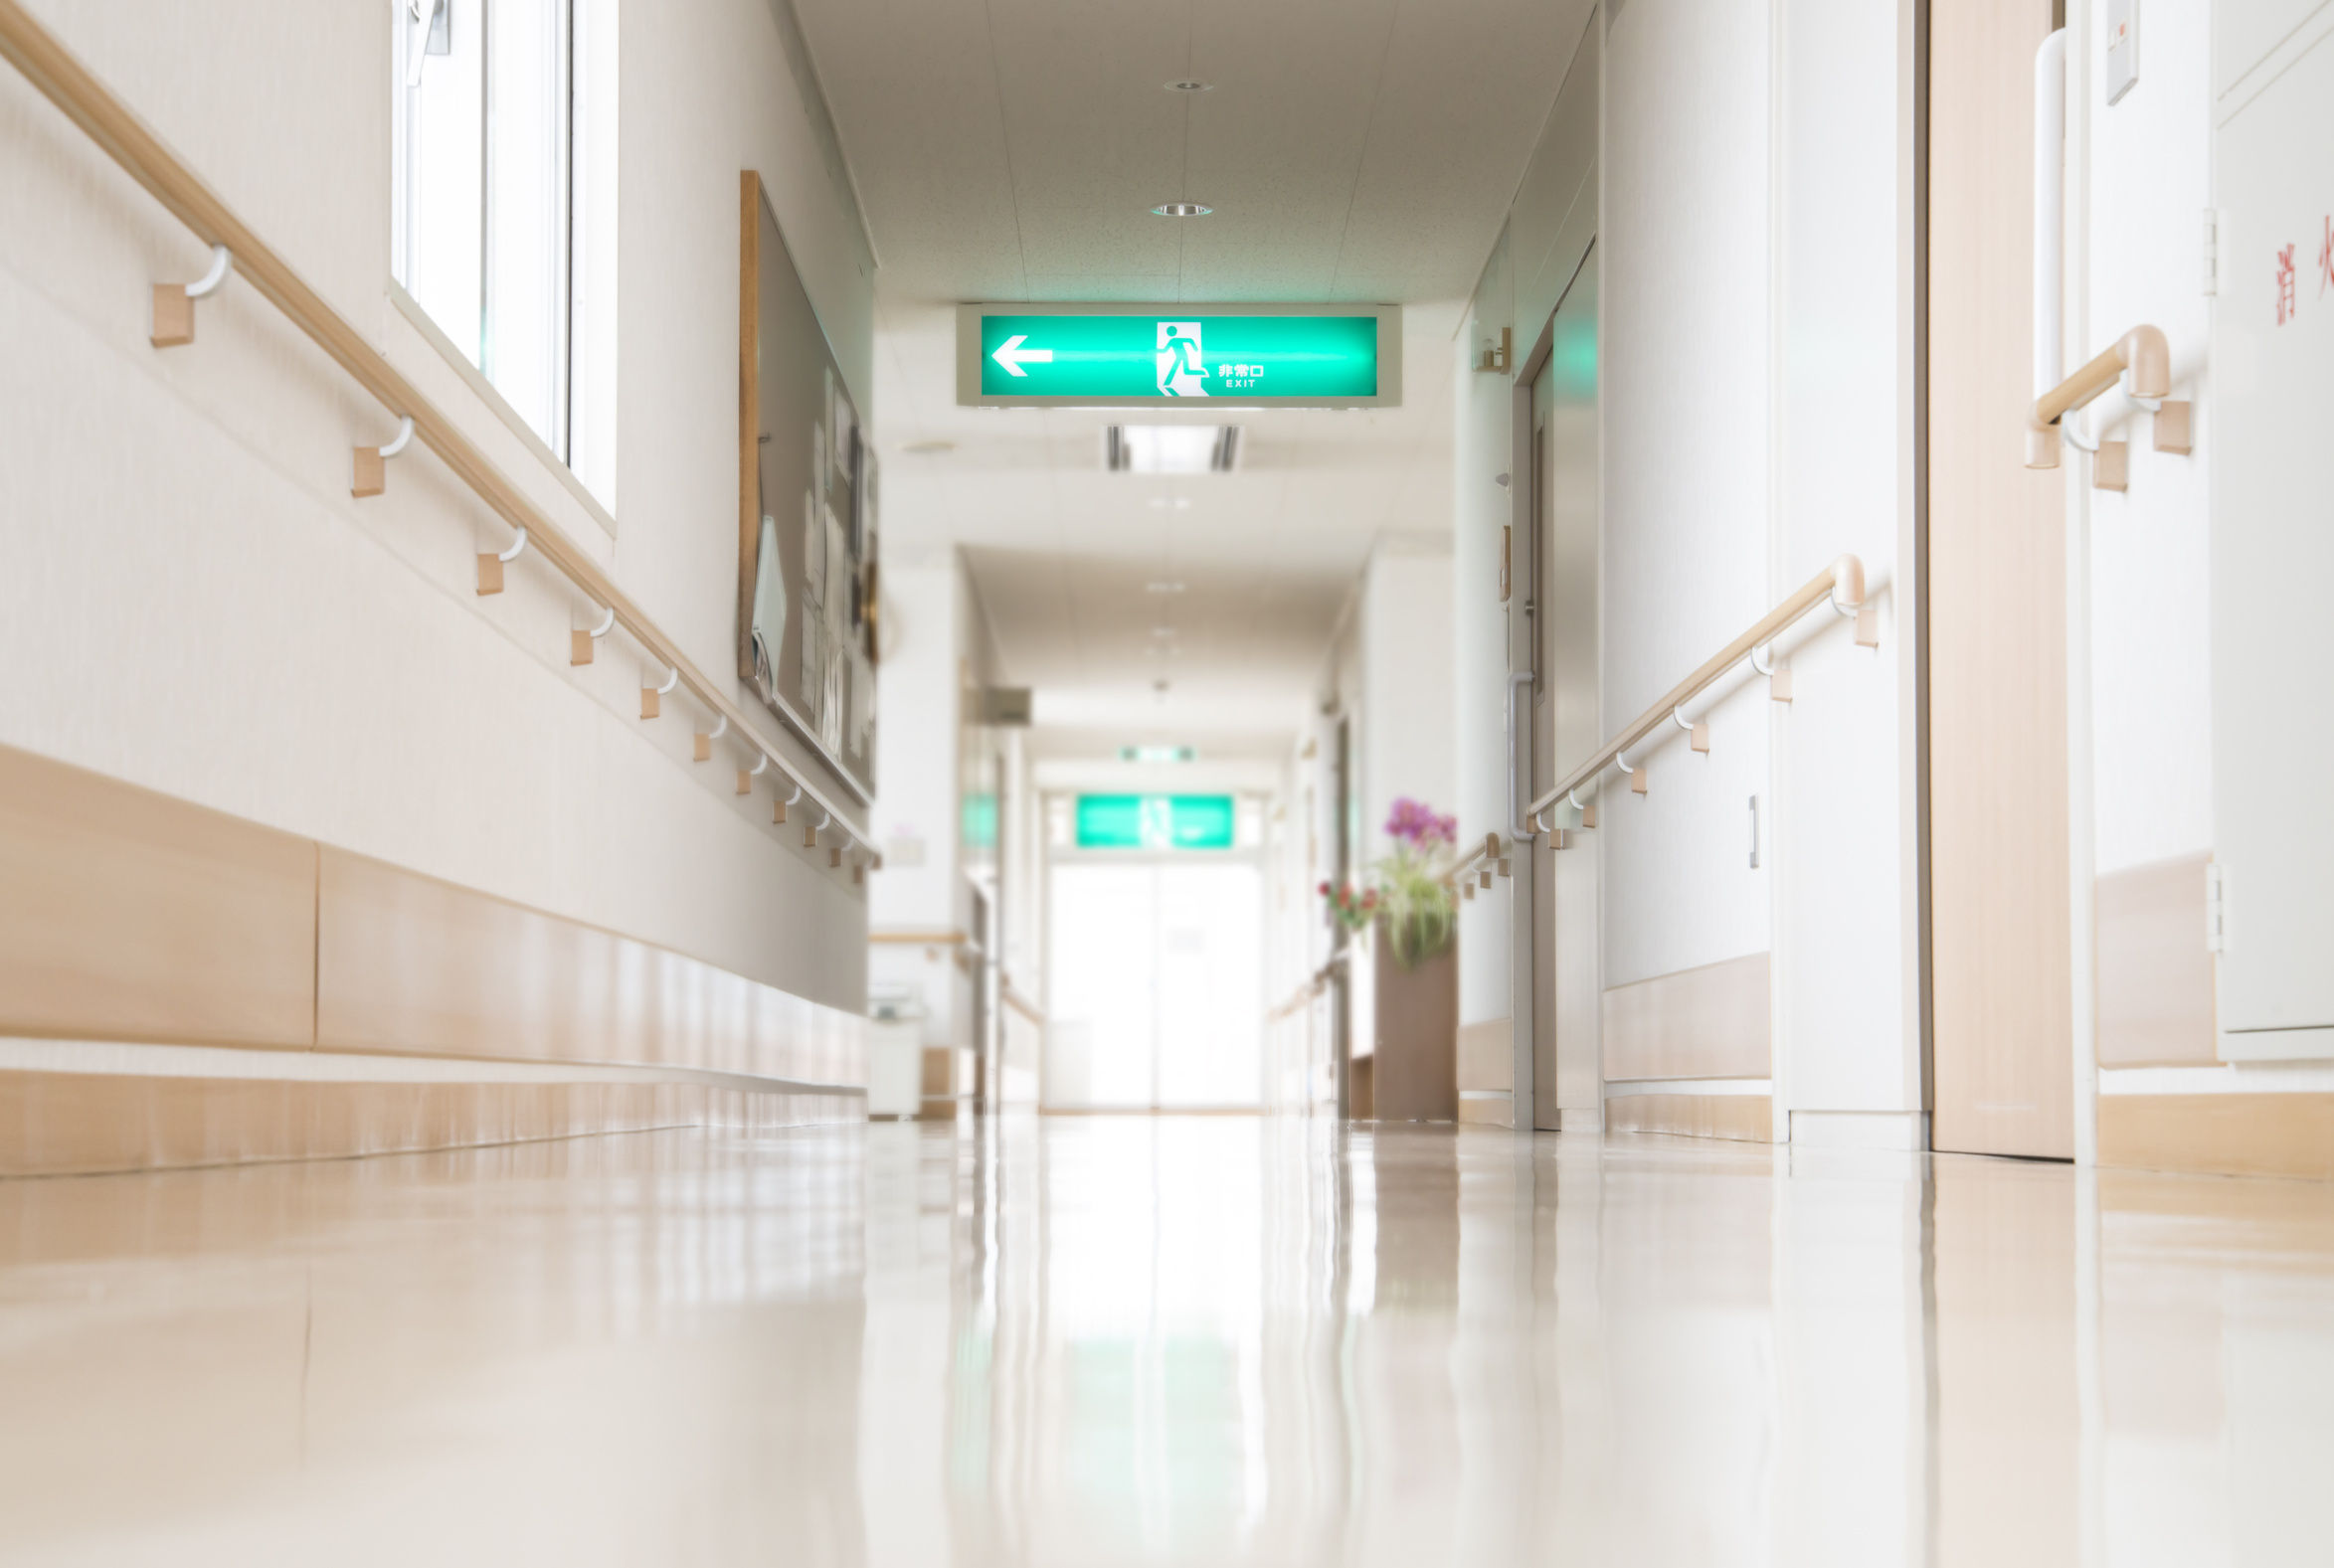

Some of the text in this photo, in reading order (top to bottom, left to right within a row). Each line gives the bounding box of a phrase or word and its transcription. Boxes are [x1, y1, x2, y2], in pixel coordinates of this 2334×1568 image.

[1218, 364, 1264, 378] 非常口
[1225, 379, 1256, 388] EXIT
